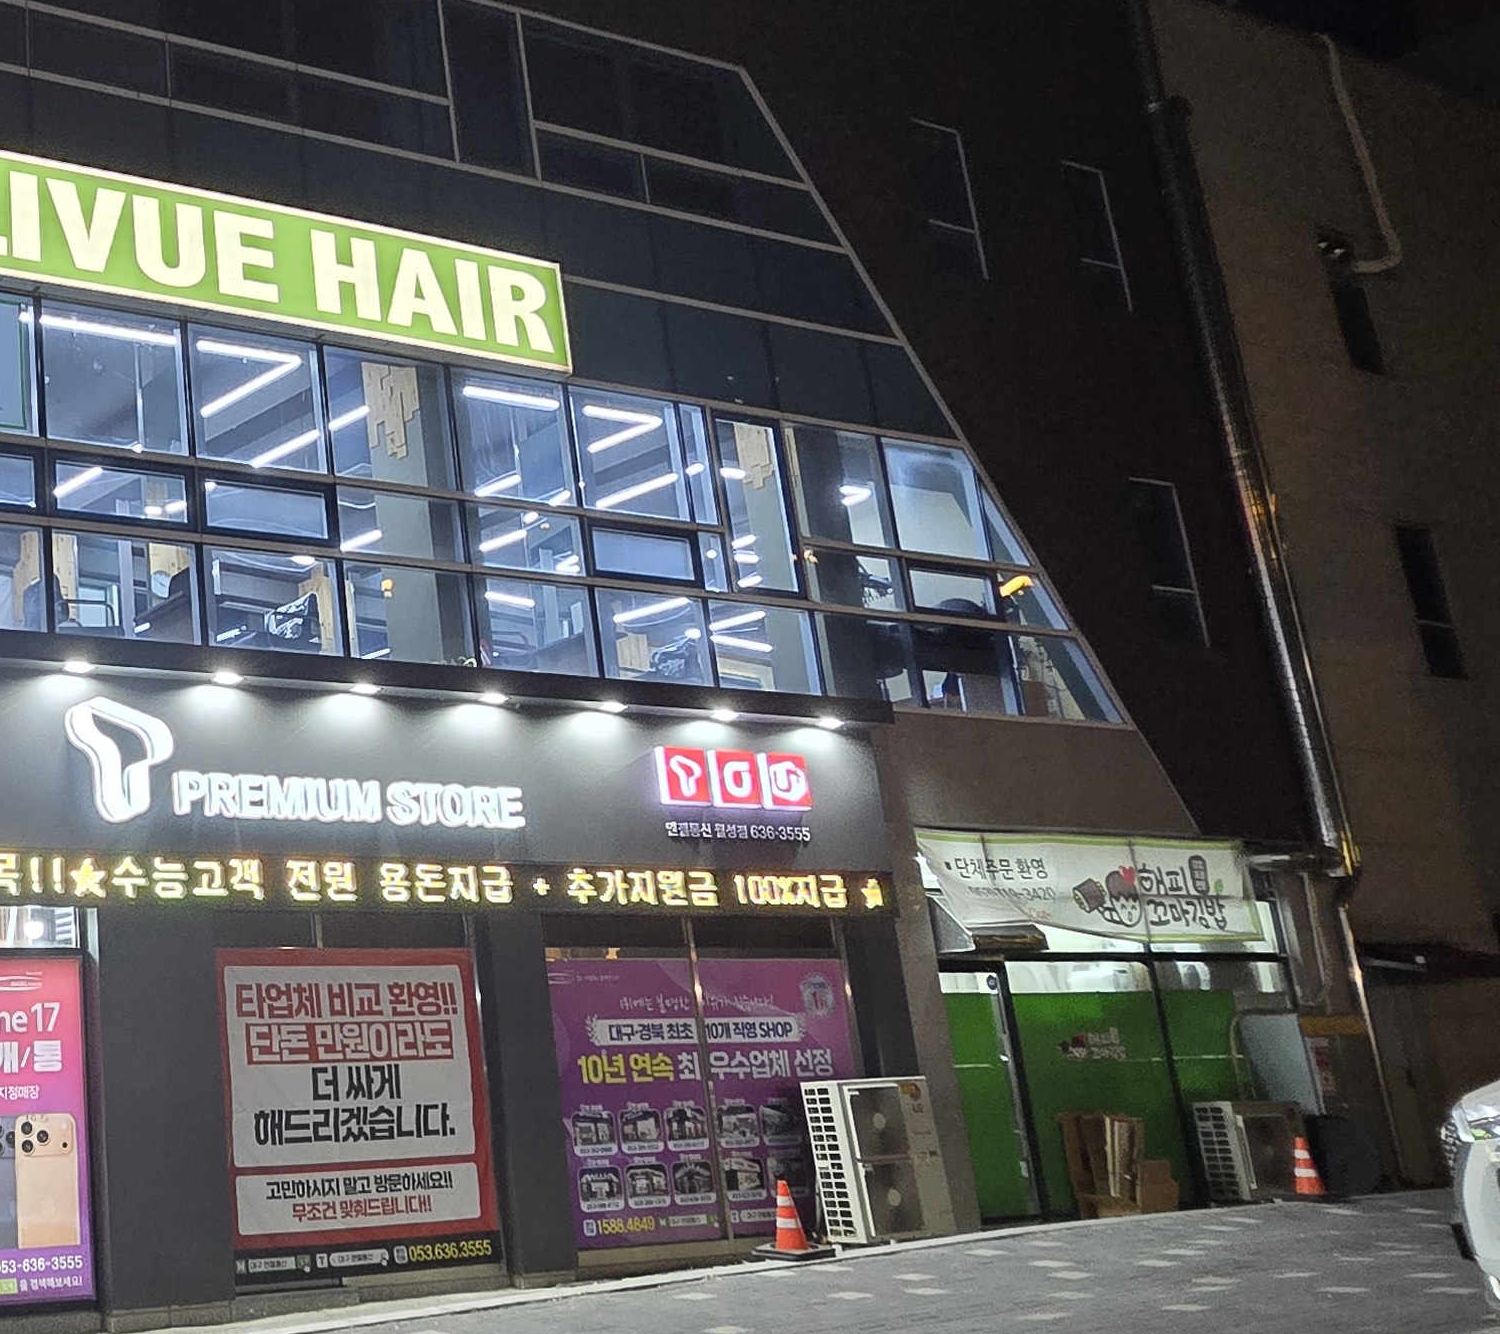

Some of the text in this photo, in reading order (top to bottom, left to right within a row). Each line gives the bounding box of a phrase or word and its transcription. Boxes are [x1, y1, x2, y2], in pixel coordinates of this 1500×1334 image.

[310, 228, 555, 354] HAIR
[173, 769, 526, 830] PREMIUM STORE
[111, 855, 265, 901] 수능고객
[286, 860, 358, 903] 전원
[378, 862, 514, 905] 용돈지급
[566, 867, 719, 909] 추가지원금
[954, 857, 1048, 880] 단체주문 환영
[1138, 863, 1190, 896] 해피
[1146, 897, 1228, 930] 꼬마김밥
[236, 981, 458, 1018] 타업체 비교 환영!!
[30, 1002, 60, 1032] 17
[608, 1020, 793, 1042] 대구·경북 최초 10개 직영 SHOP
[250, 1020, 452, 1061] 단돈 만원이라도
[312, 1063, 402, 1102] 더 싸게
[577, 1053, 628, 1084] 10년
[629, 1052, 675, 1083] 연속
[794, 1048, 834, 1077] 선정
[254, 1103, 456, 1146] 해드리겠습니다.
[266, 1171, 454, 1200] 고민하시지 말고 방문하세요!!
[292, 1194, 433, 1222] 무조건 맞춰드립니다!!
[597, 1216, 655, 1235] 1588.4849
[408, 1239, 492, 1264] 053.636.3555
